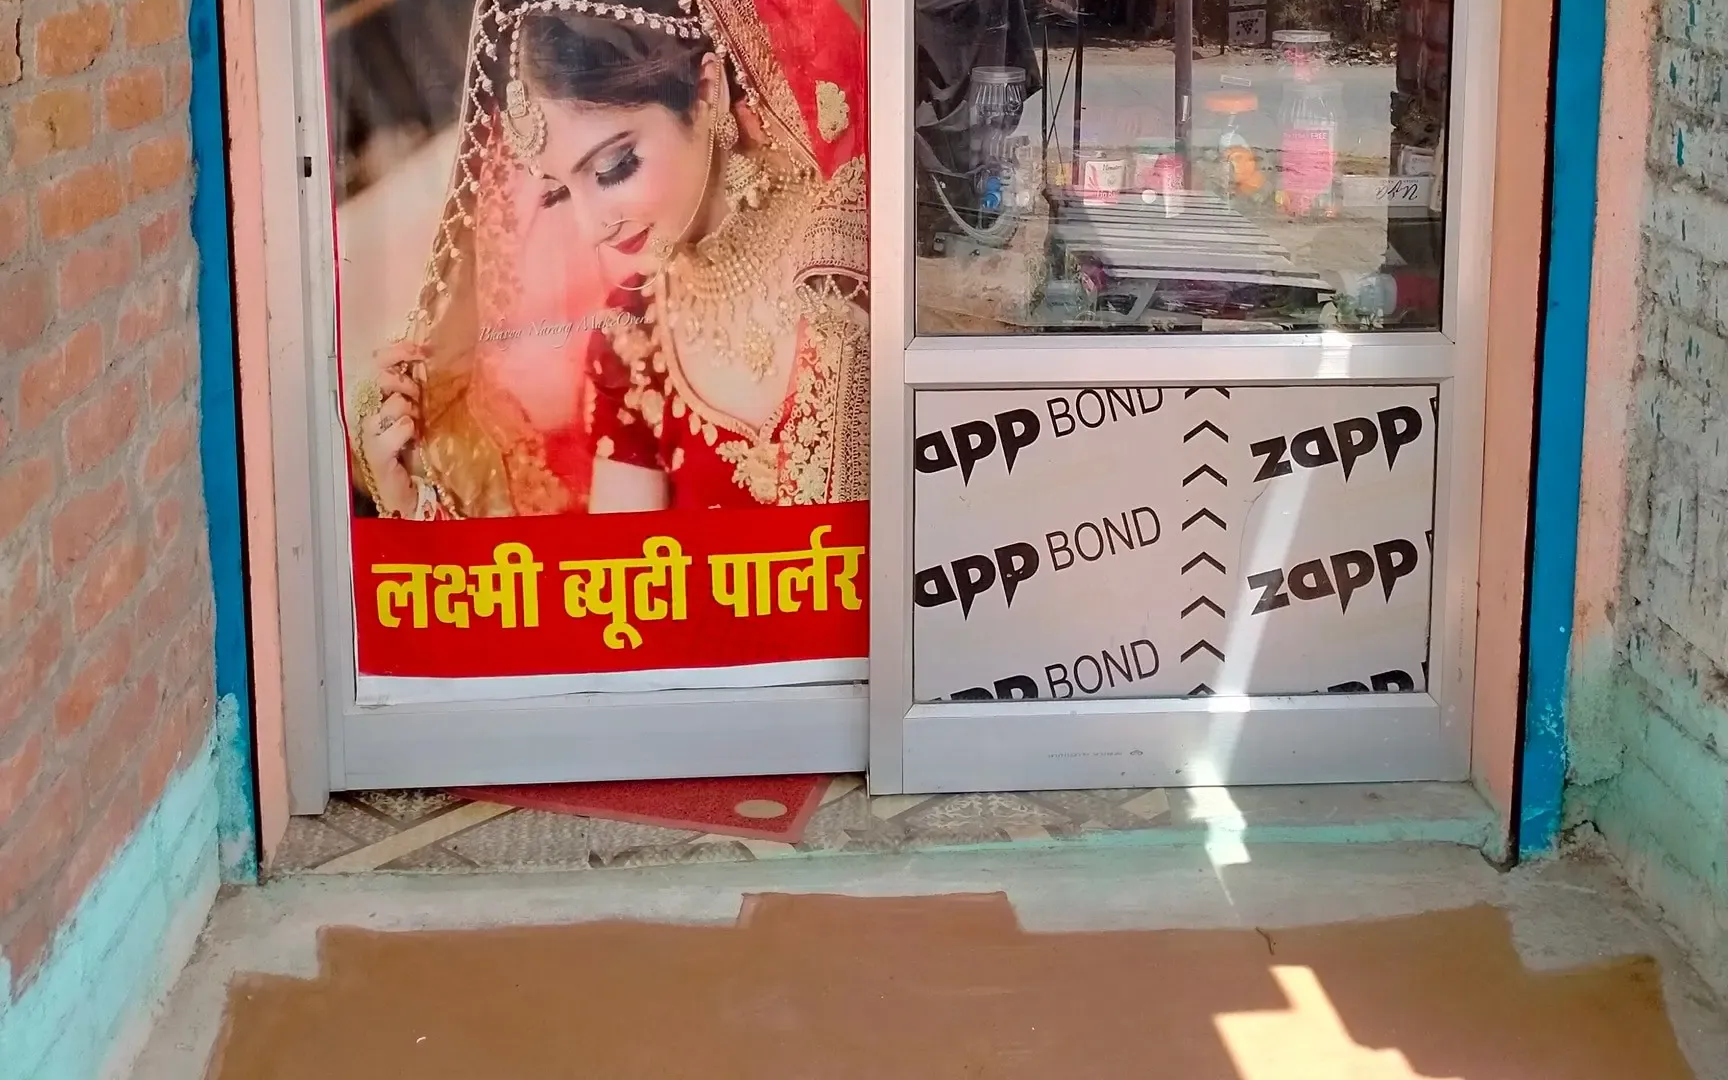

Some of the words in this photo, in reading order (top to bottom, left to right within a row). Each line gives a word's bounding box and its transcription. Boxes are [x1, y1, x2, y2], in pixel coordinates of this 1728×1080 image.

[1046, 388, 1164, 438] BOND
[1249, 405, 1423, 484] zapp
[1045, 506, 1162, 572] BOND
[371, 542, 544, 629] लक्ष्मी
[558, 535, 693, 650] ब्यूटी
[707, 525, 866, 618] पार्लर
[1246, 538, 1419, 616] zapp
[1044, 638, 1160, 699] BOND
